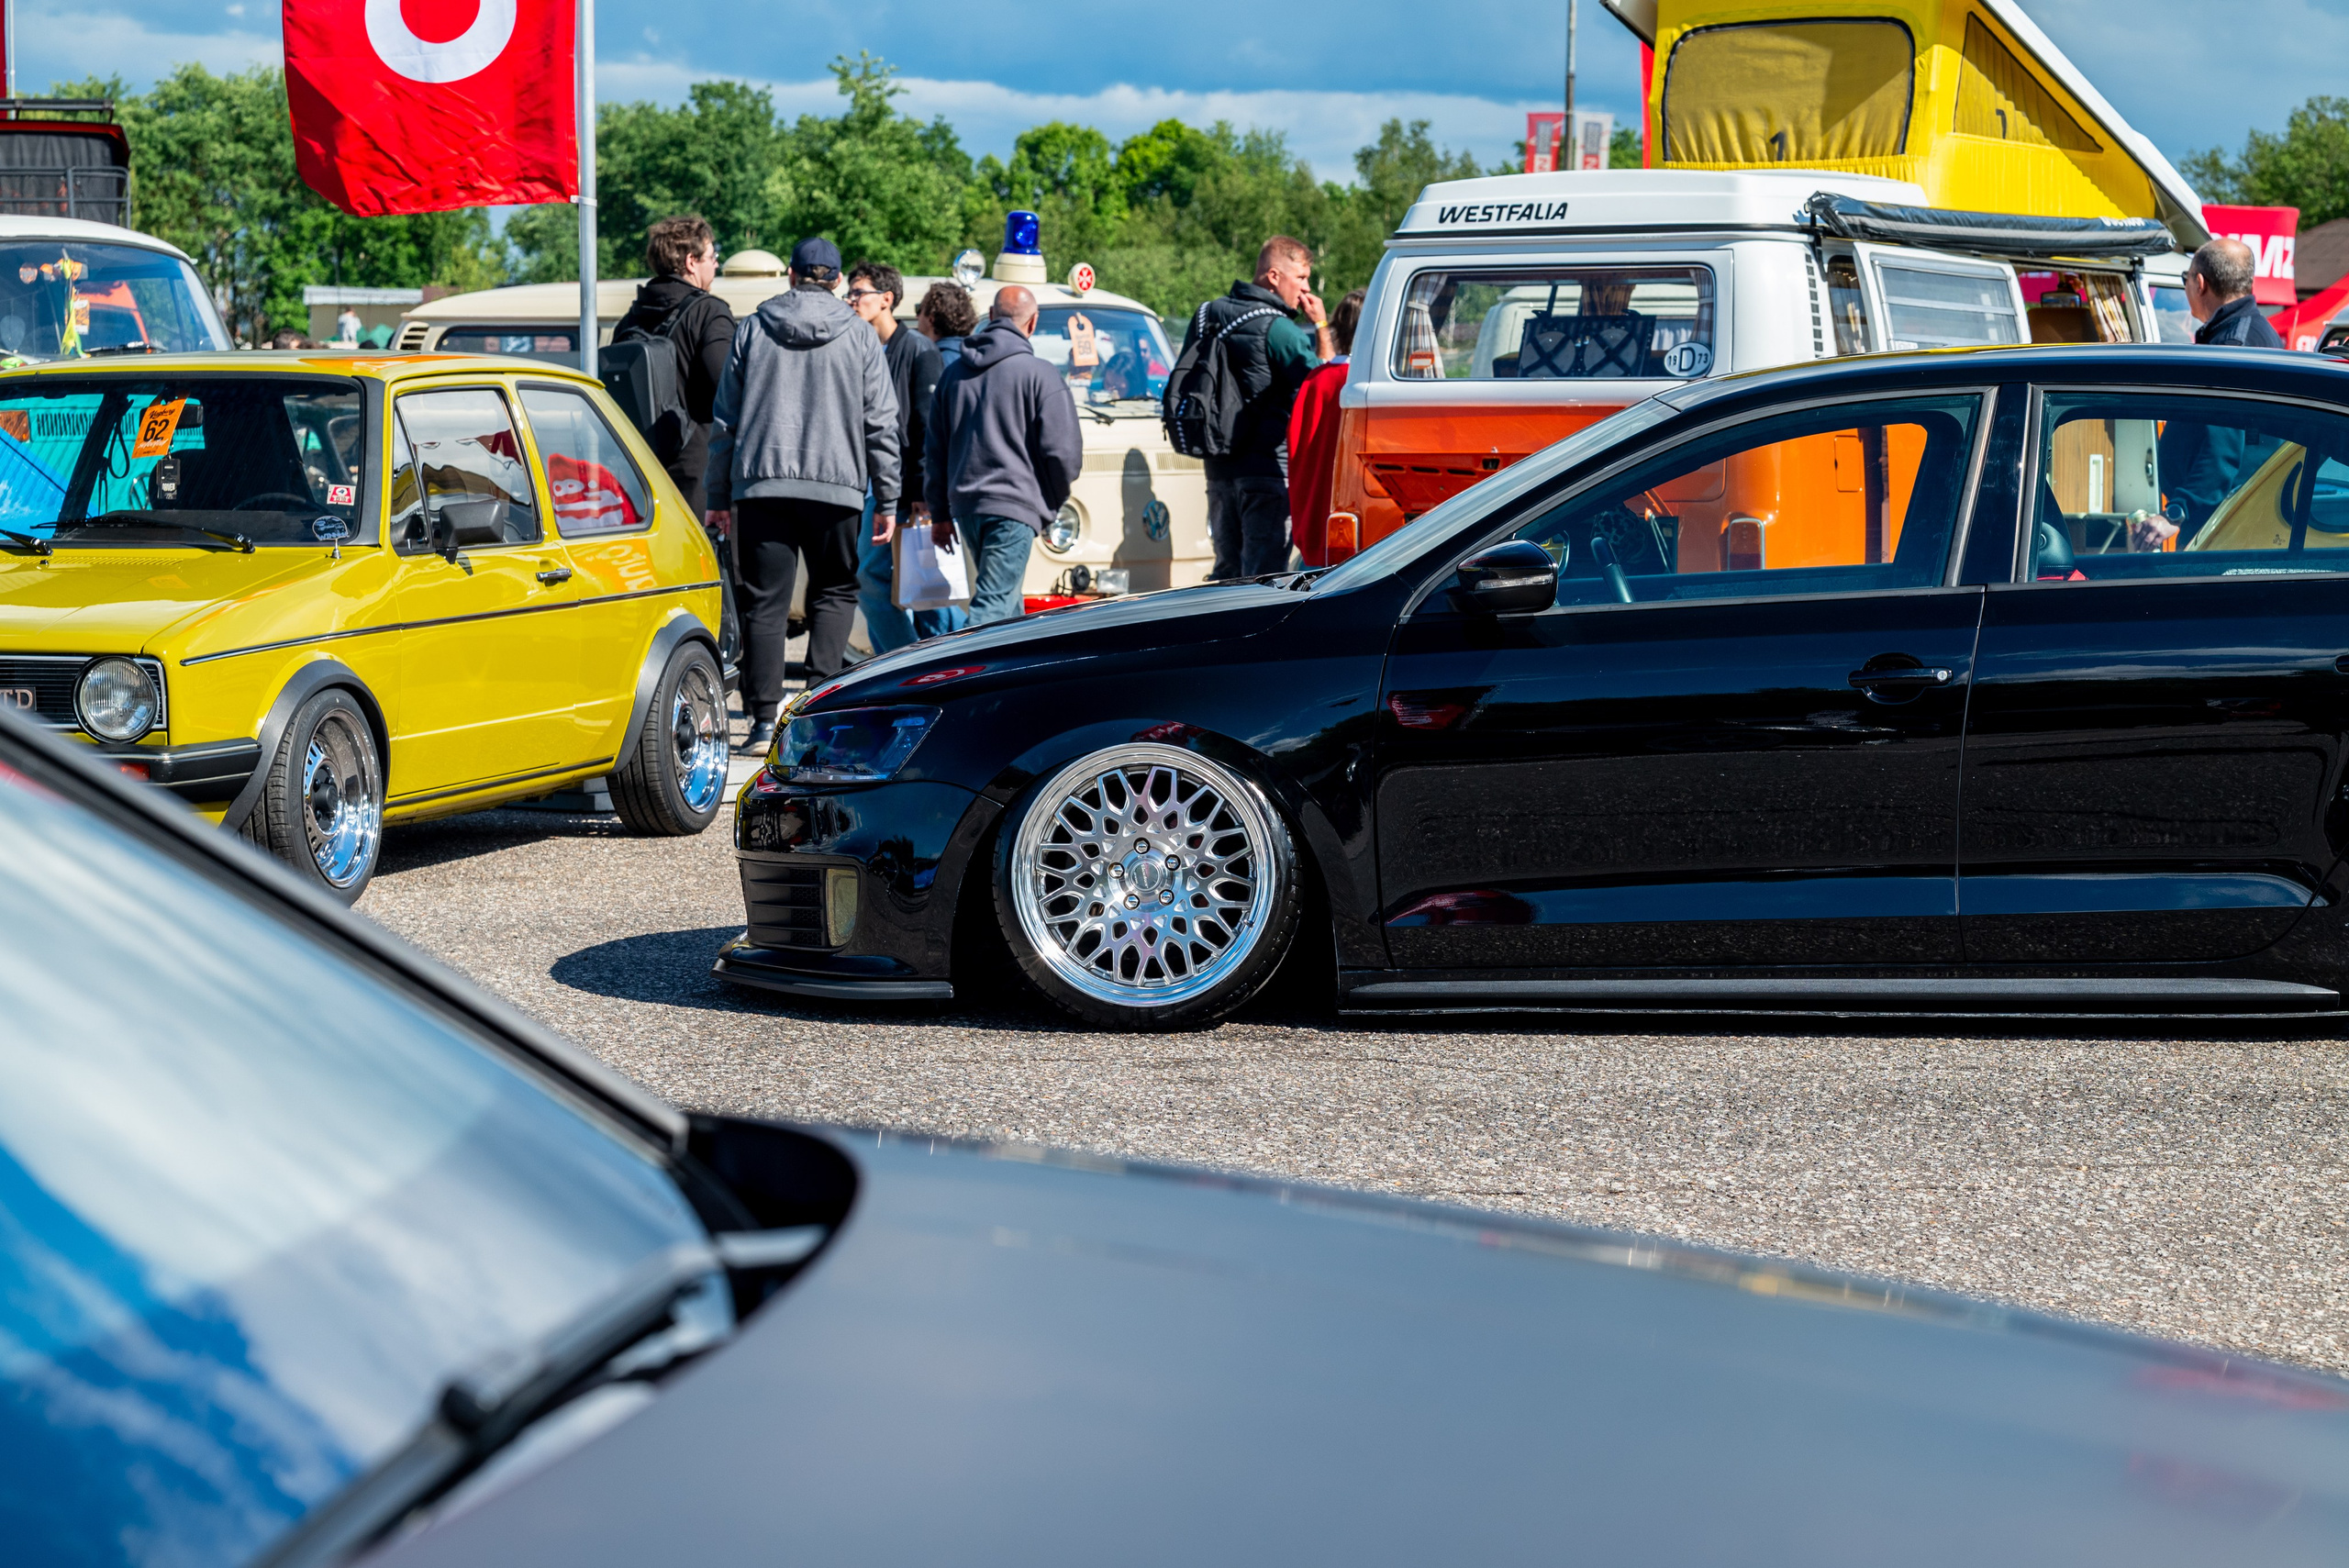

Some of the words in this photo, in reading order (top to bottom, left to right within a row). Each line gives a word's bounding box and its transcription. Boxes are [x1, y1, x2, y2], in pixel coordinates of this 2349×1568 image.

[1438, 202, 1568, 224] WESTFALIA
[1668, 355, 1678, 366] 19
[1679, 347, 1696, 373] D
[1698, 352, 1709, 364] 73
[143, 418, 170, 442] 62
